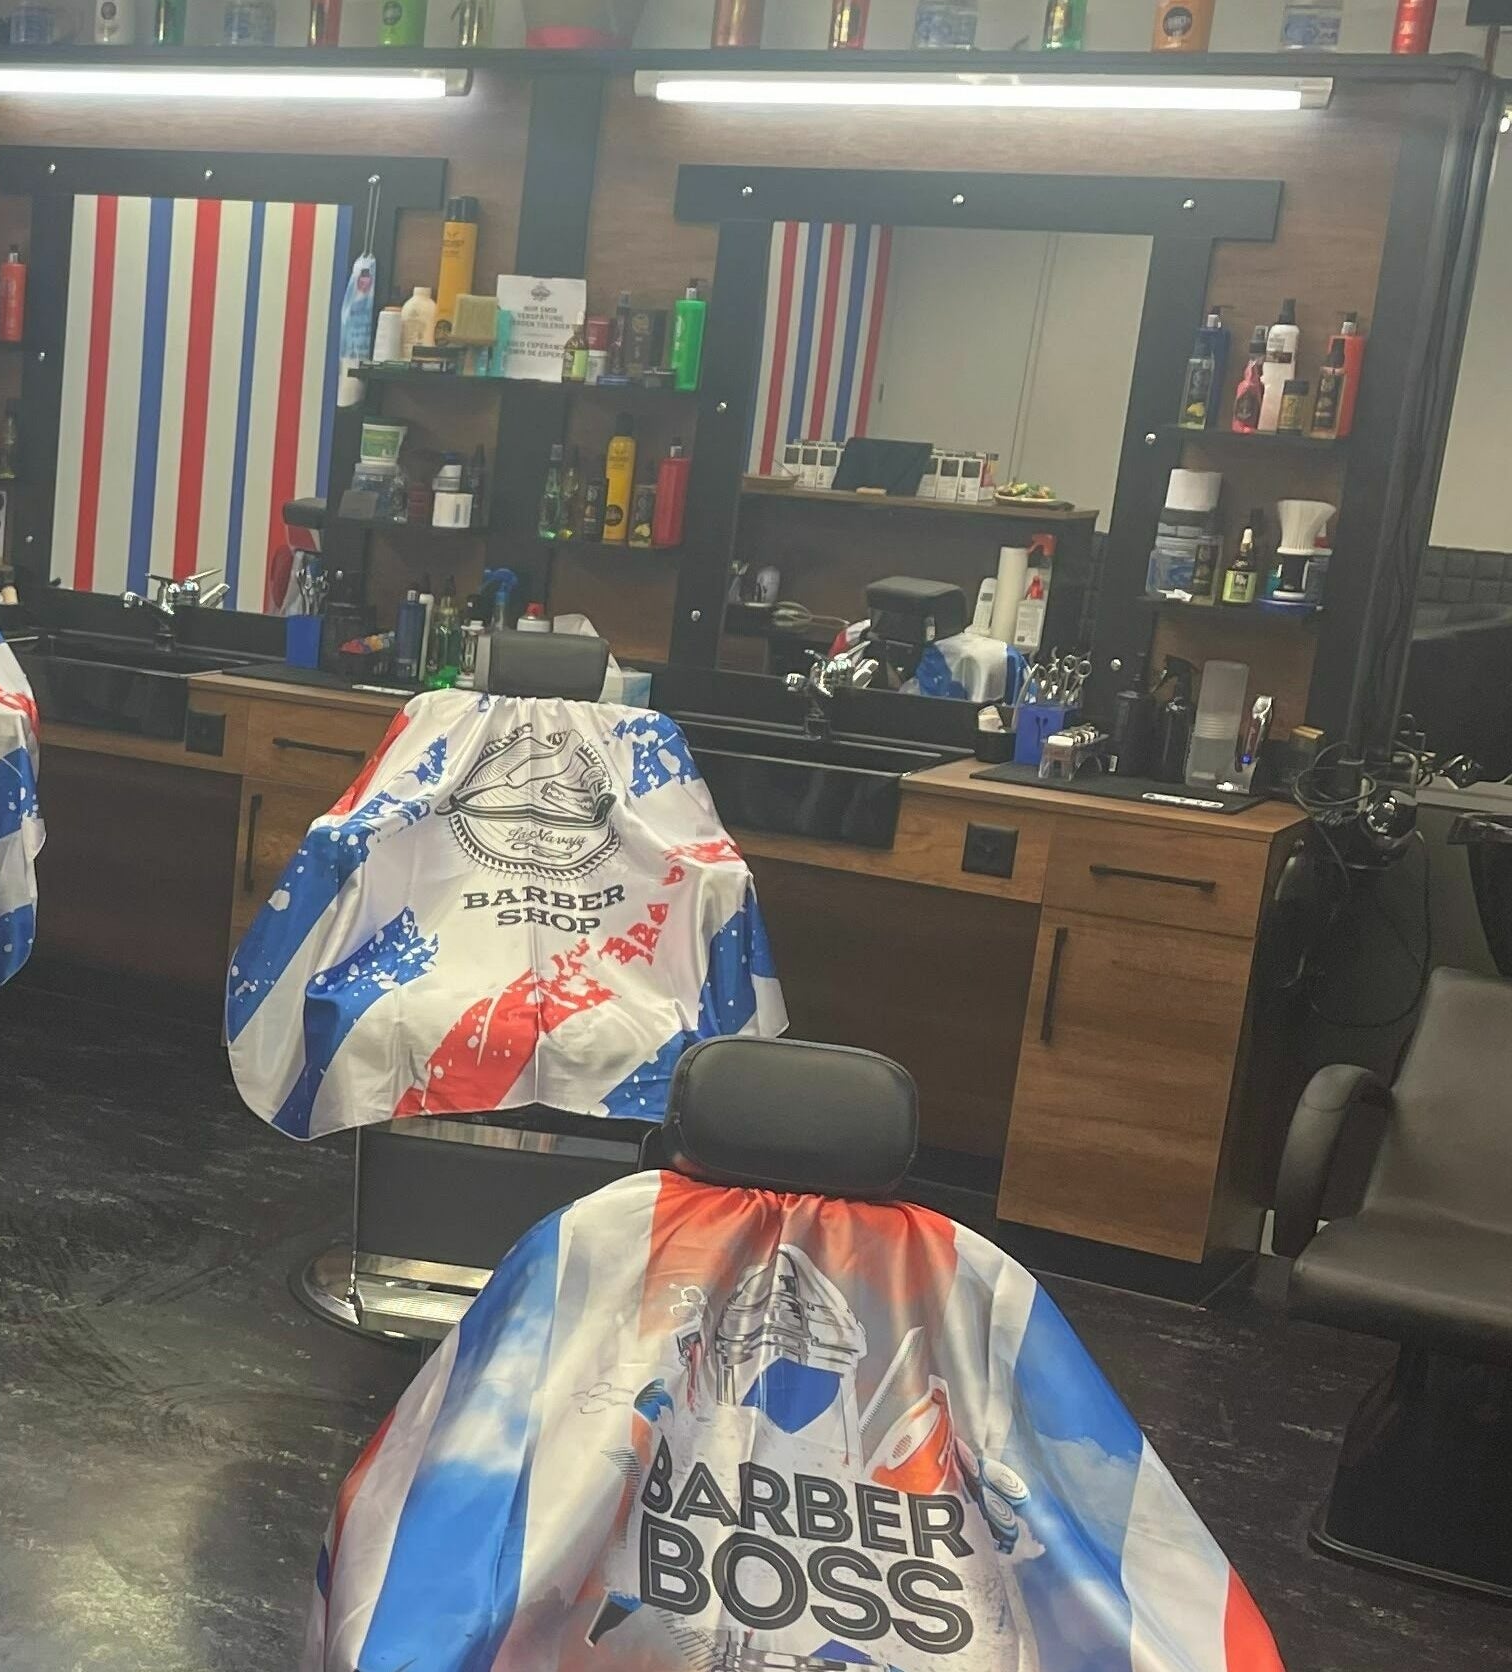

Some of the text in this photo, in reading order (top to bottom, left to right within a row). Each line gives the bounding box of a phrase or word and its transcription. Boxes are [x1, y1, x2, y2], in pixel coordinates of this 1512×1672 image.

[463, 884, 626, 912] BARBER
[496, 907, 601, 934] SHOP
[641, 1435, 975, 1559] BARBER
[640, 1510, 975, 1655] BOSS
